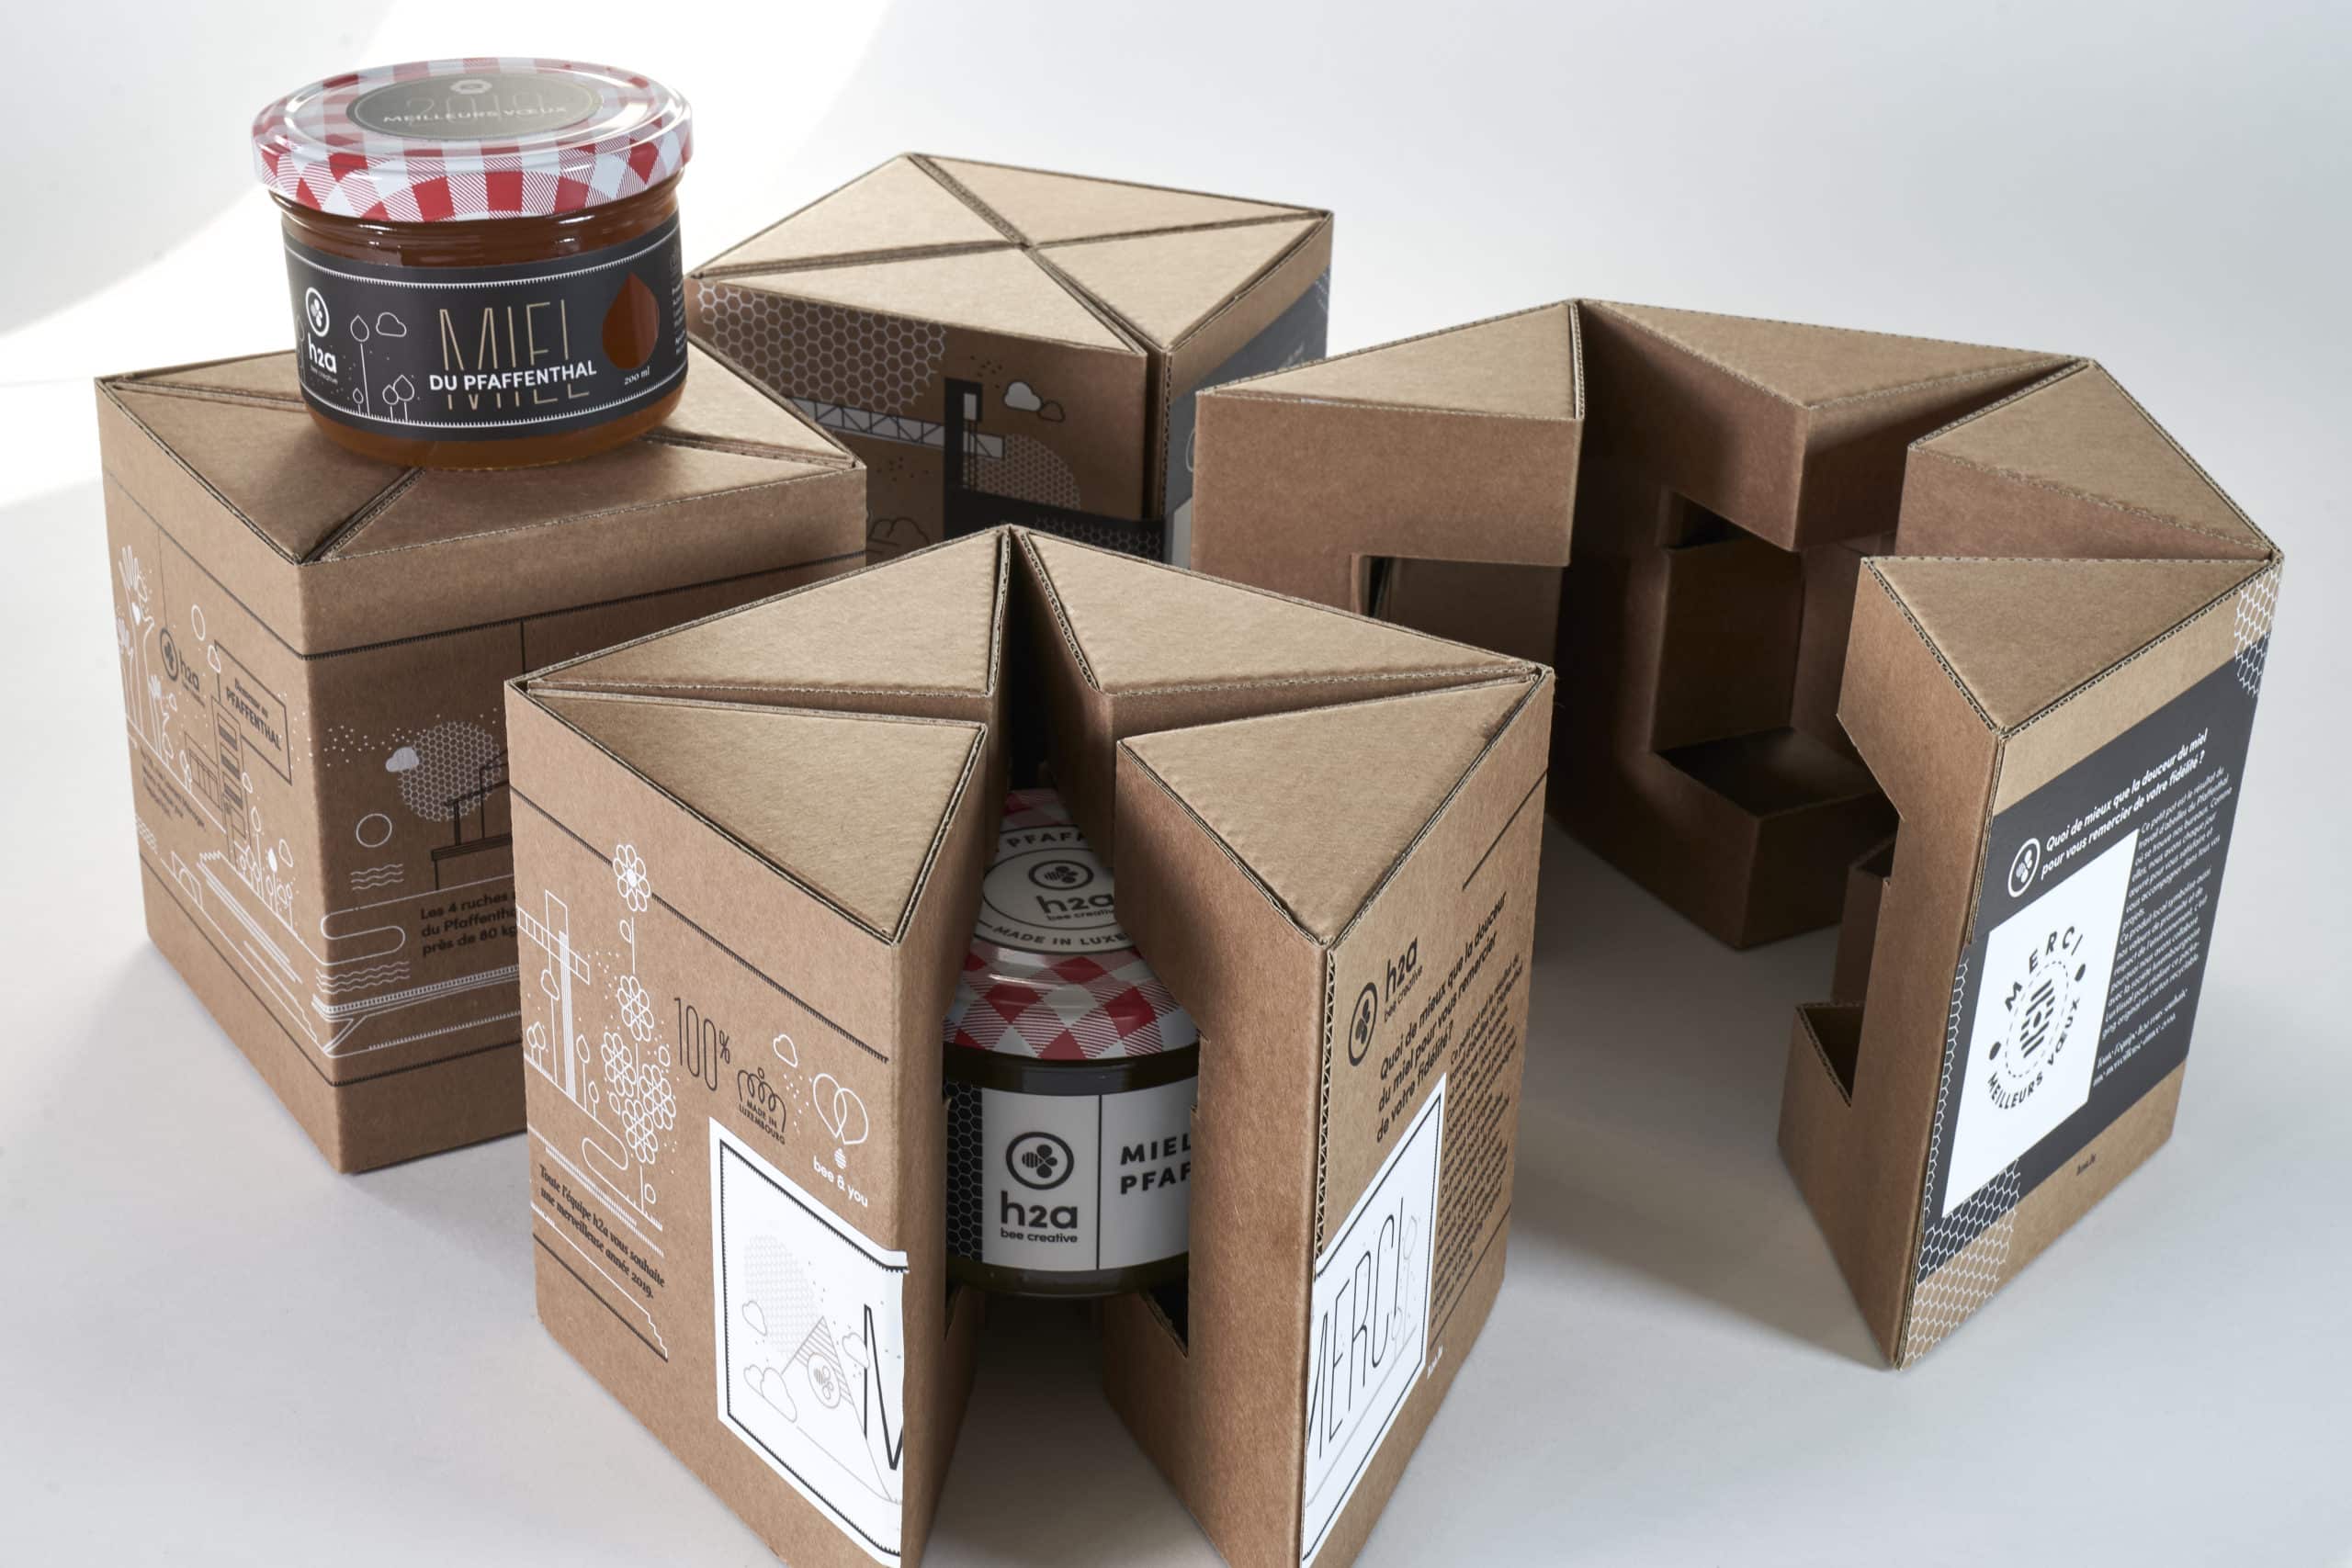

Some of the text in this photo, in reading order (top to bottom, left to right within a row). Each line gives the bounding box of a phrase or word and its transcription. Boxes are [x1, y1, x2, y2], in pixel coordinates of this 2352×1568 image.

[383, 109, 499, 123] MEILLEURS
[308, 333, 337, 374] h2a
[429, 360, 597, 390] DU PFAFFENTHAL
[625, 366, 650, 385] 200 ml
[2047, 728, 2208, 851] Quoi de mieux que la douceur du miel
[2041, 852, 2064, 880] pour
[2066, 838, 2086, 858] vous
[2088, 806, 2132, 840] remercier
[2133, 795, 2144, 810] de
[2146, 781, 2167, 801] votre
[461, 893, 507, 910] ruches
[1035, 893, 1114, 914] h2a
[422, 924, 440, 937] du
[458, 933, 476, 946] de
[993, 925, 1046, 944] MADE
[1053, 937, 1071, 946] IN
[1381, 891, 1506, 1080] Quoi de mieux que la douceur
[1385, 937, 1419, 1003] h2a
[2005, 926, 2083, 1011] MERCI
[1379, 931, 1496, 1112] du miel pour vous remercier
[674, 998, 730, 1091] 100%
[1987, 1071, 2044, 1110] MEILLEURS
[739, 1102, 785, 1145] LUXEMBOURG
[747, 1100, 777, 1129] MADE IN
[1377, 1118, 1389, 1143] de
[1391, 1080, 1415, 1122] votre
[1120, 1133, 1192, 1165] MIEL
[813, 1155, 834, 1182] bee
[847, 1184, 868, 1208] you
[539, 1164, 560, 1193] Toute
[593, 1213, 608, 1237] h2a
[610, 1232, 628, 1255] vous
[629, 1251, 665, 1288] souhaite
[1001, 1190, 1078, 1229] h2a
[540, 1188, 555, 1207] une
[557, 1203, 604, 1253] merveilleuse
[605, 1249, 629, 1276] année
[1001, 1227, 1078, 1244] bee creative
